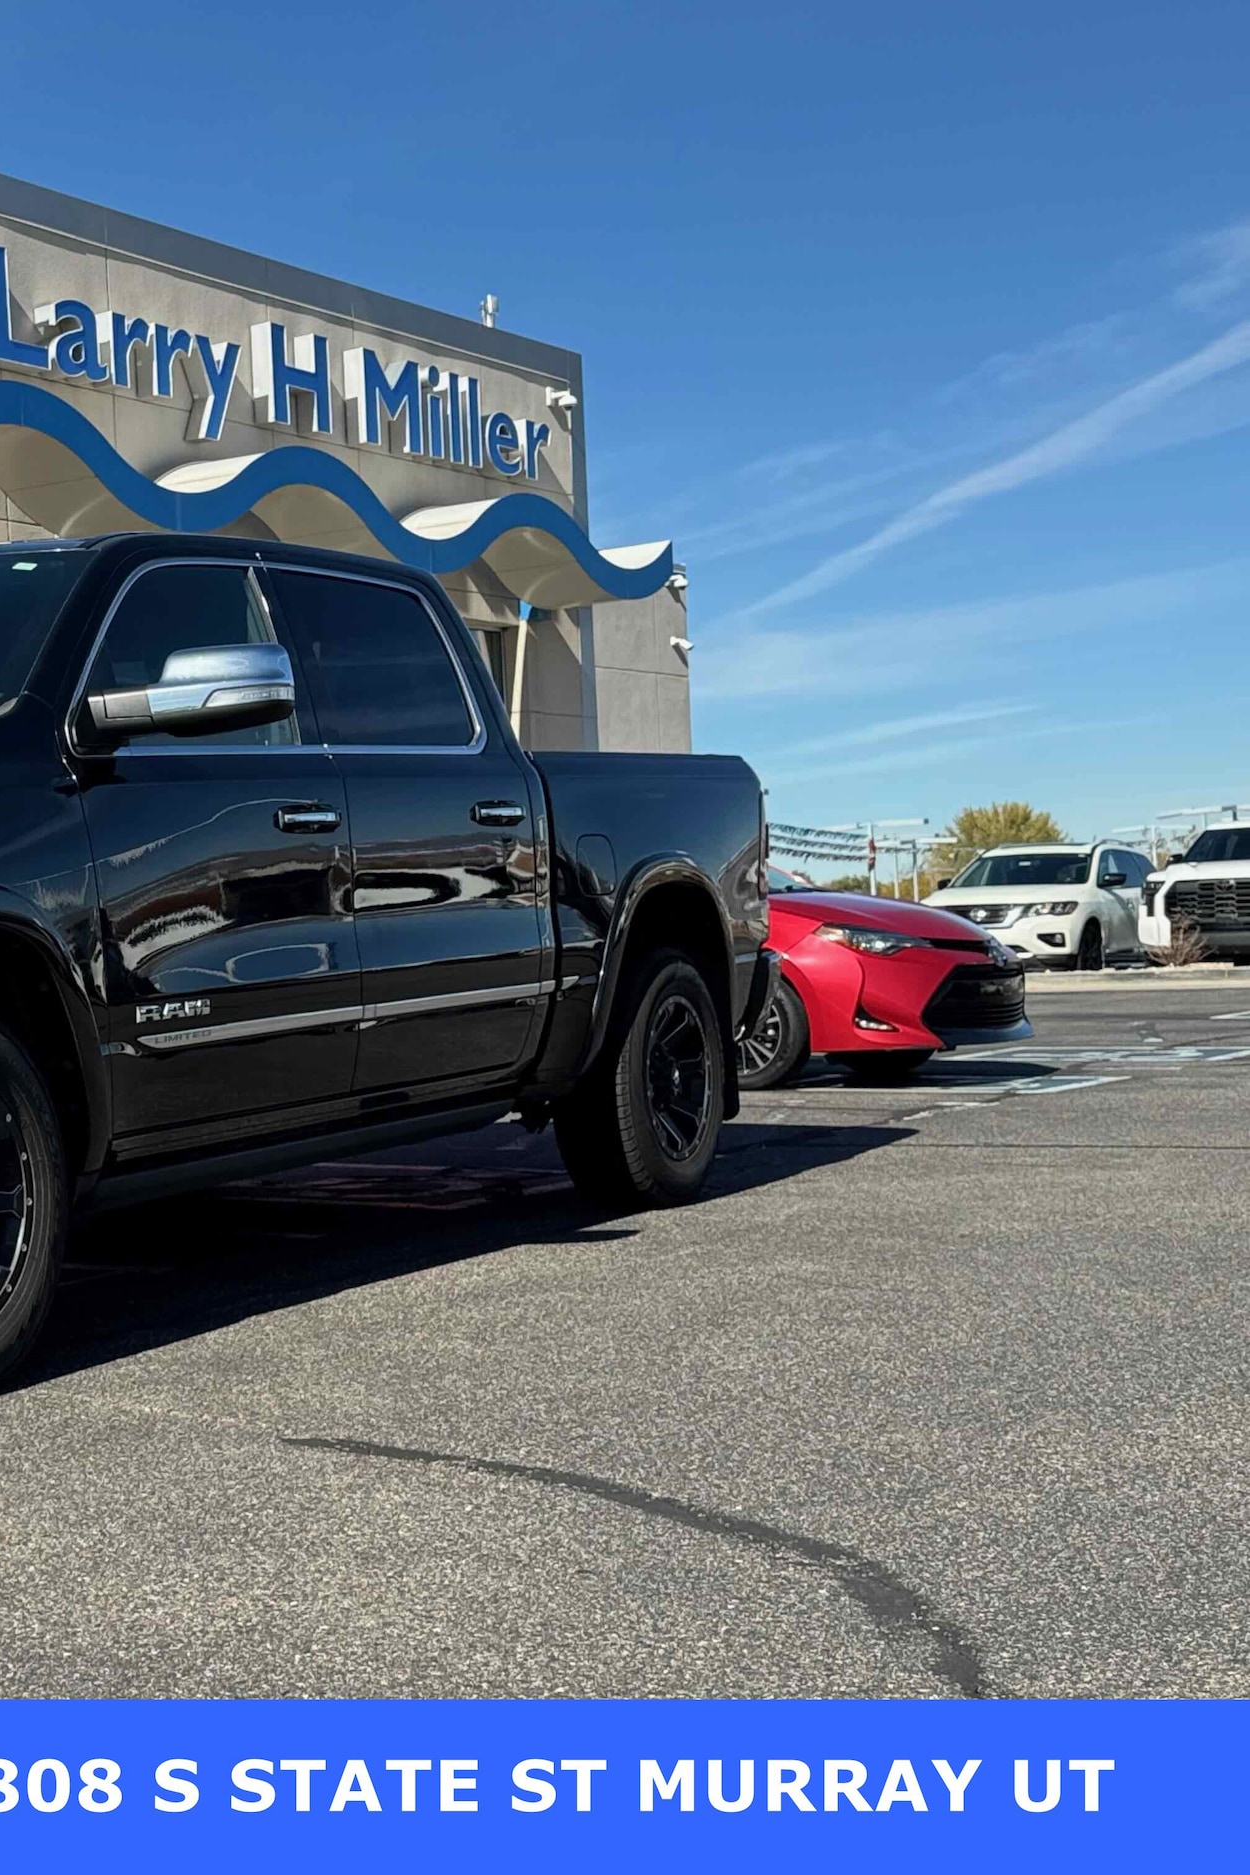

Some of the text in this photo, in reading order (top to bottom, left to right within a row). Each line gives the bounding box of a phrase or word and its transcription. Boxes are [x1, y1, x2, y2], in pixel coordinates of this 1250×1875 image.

[251, 319, 334, 434] H
[343, 346, 552, 480] Miller
[136, 999, 211, 1023] RAM
[154, 1029, 212, 1044] LIMITED
